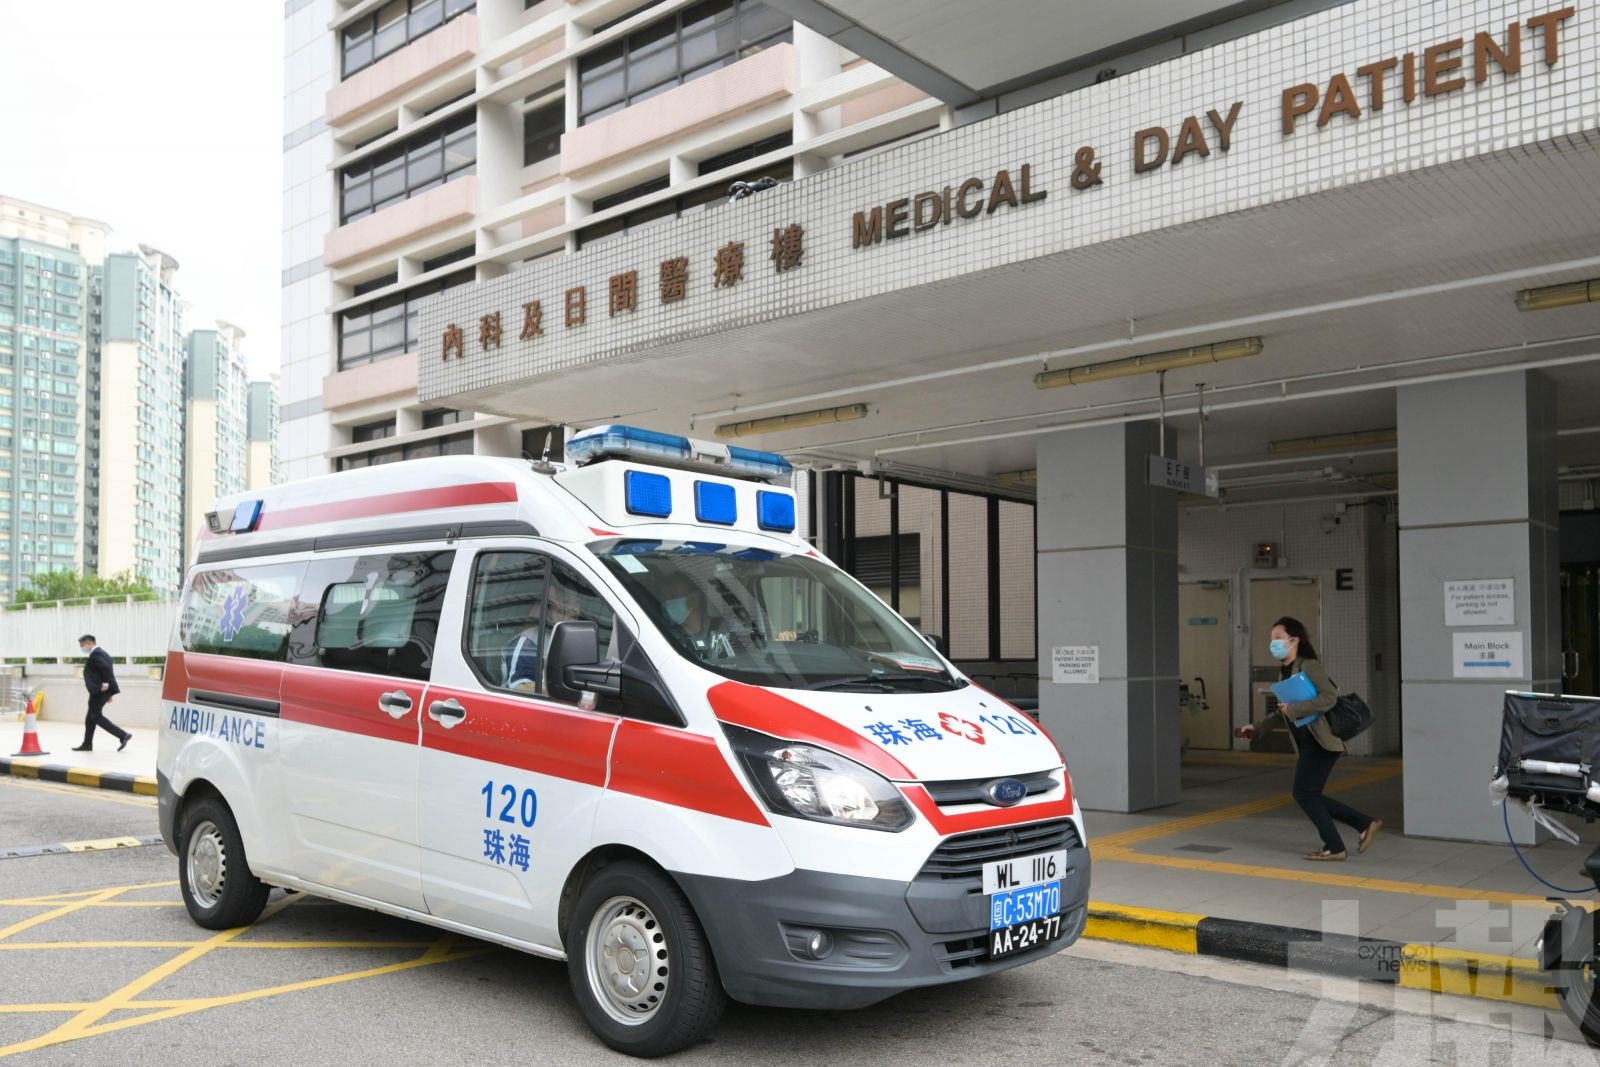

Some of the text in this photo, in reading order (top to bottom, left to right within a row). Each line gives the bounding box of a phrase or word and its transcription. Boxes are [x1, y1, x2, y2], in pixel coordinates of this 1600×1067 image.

[852, 6, 1575, 249] MEDICAL & DAY PATIENT
[1335, 568, 1354, 591] E
[1464, 642, 1510, 650] Main Block
[169, 705, 265, 749] AMBULANCE
[863, 714, 1038, 746] 珠海 120
[481, 780, 538, 829] 120
[483, 828, 531, 873] 珠海
[996, 855, 1057, 889] WL 1116
[993, 916, 1061, 956] AA-24-77
